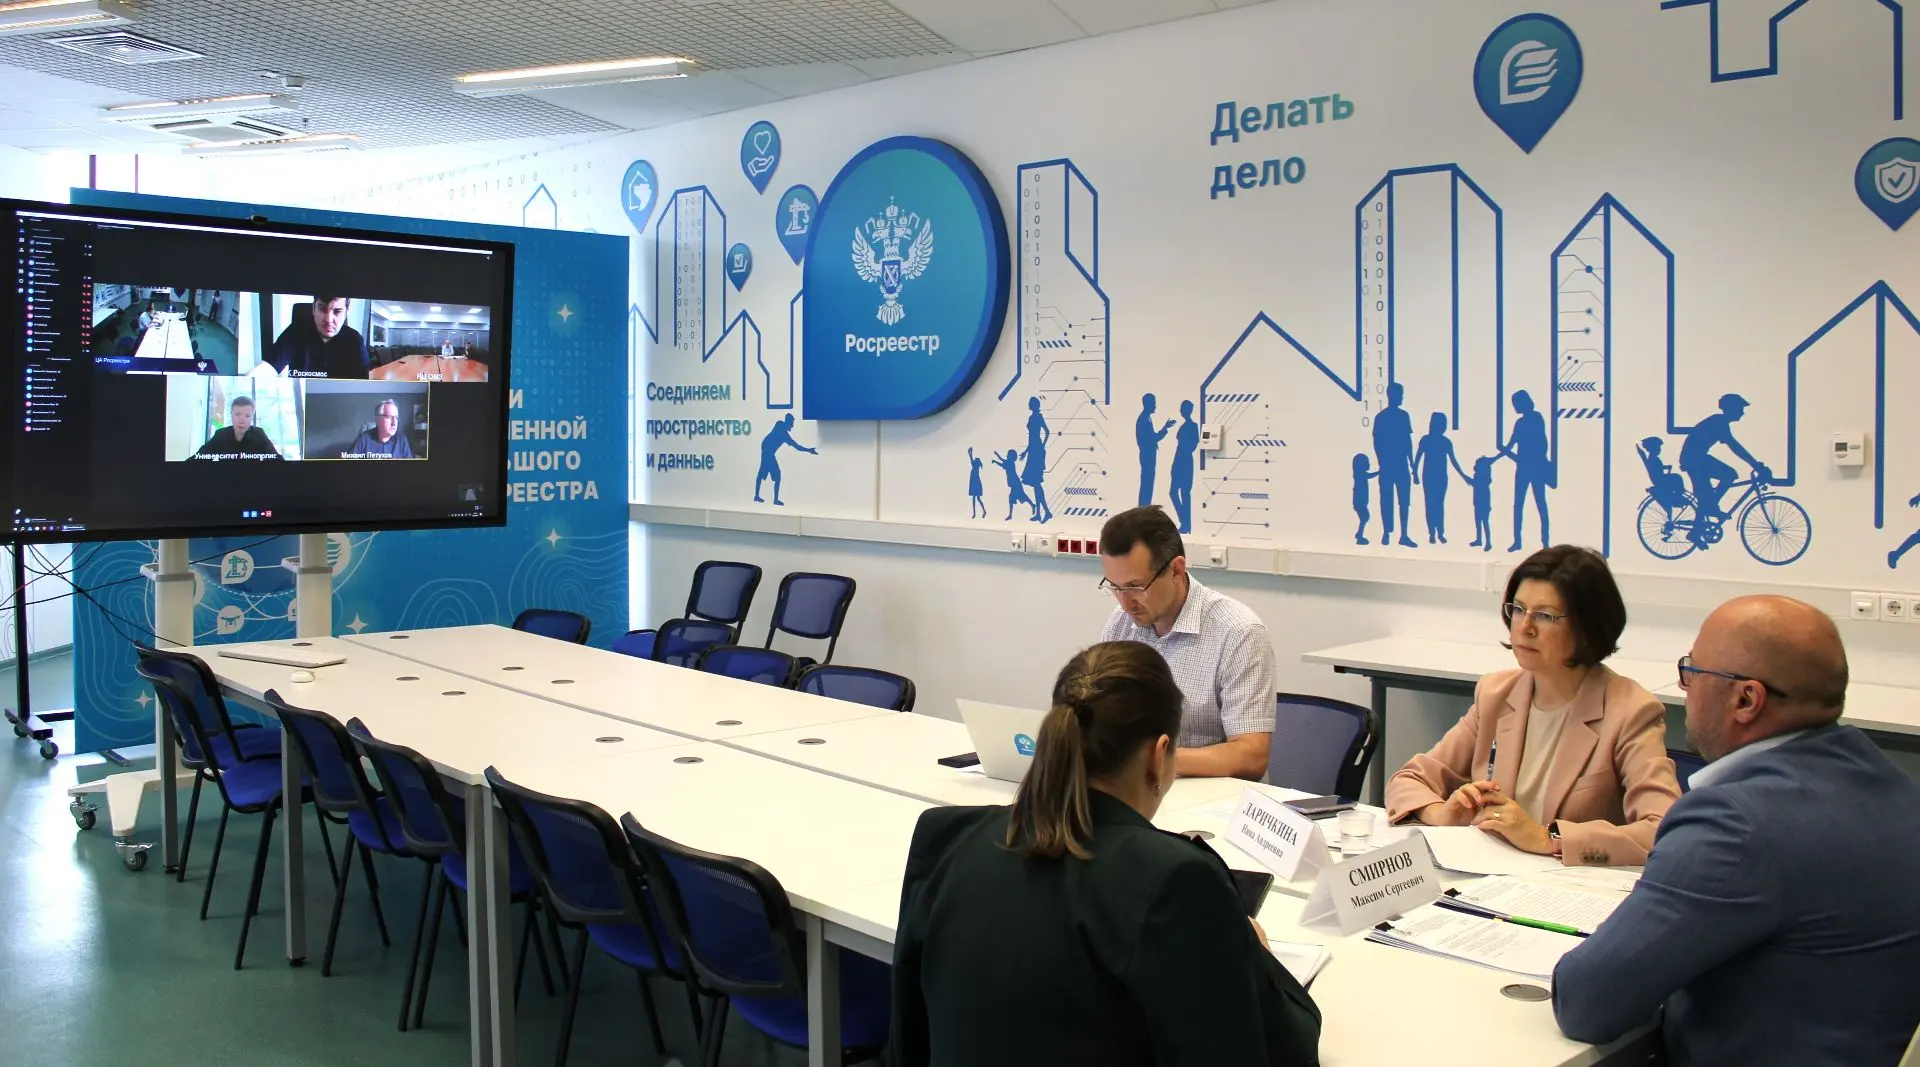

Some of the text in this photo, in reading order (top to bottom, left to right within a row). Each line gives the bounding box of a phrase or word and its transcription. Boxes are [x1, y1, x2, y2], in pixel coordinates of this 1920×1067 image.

[1210, 93, 1355, 146] Делать
[1210, 156, 1306, 200] дело
[845, 333, 940, 357] Росреестр
[293, 369, 328, 378] Роскосмос
[646, 381, 731, 405] Соединяем
[508, 415, 587, 440] ЕННОЙ
[646, 419, 752, 441] пространство
[194, 452, 277, 462] Университет Иннополис
[340, 451, 393, 460] Михаил Петухов
[646, 453, 715, 472] и данные
[1242, 802, 1298, 846] ЛАРИЧКИНА
[1241, 823, 1284, 859] Нина Андреевна
[1348, 851, 1413, 887] СМИРНОВ
[1350, 875, 1425, 909] Максим Сергеевич
